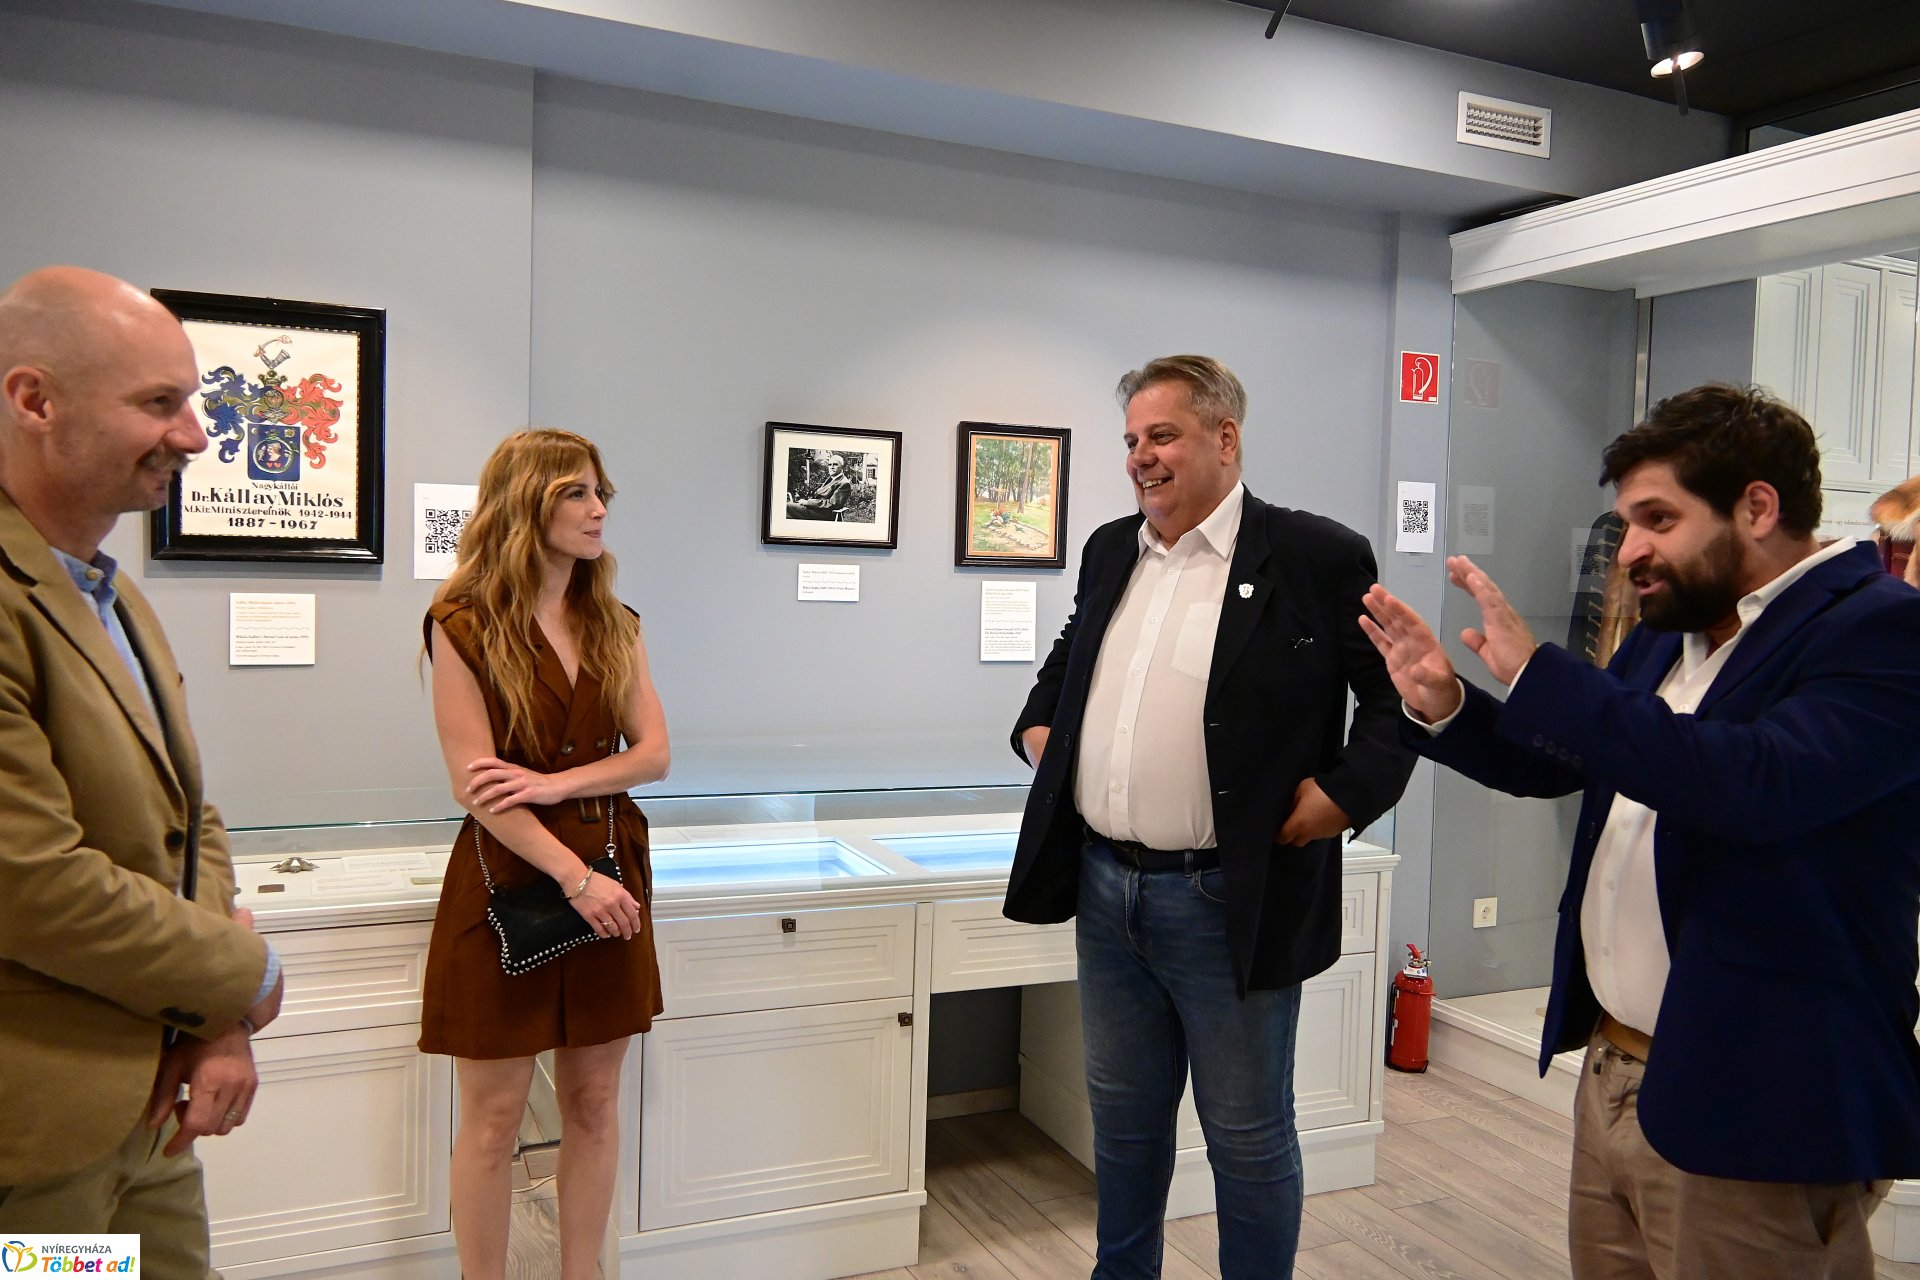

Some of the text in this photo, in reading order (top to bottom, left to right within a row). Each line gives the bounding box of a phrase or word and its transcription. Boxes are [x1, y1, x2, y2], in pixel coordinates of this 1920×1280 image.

[252, 482, 298, 491] Nagykállói
[210, 487, 277, 508] Kállay
[279, 490, 344, 508] Miklós
